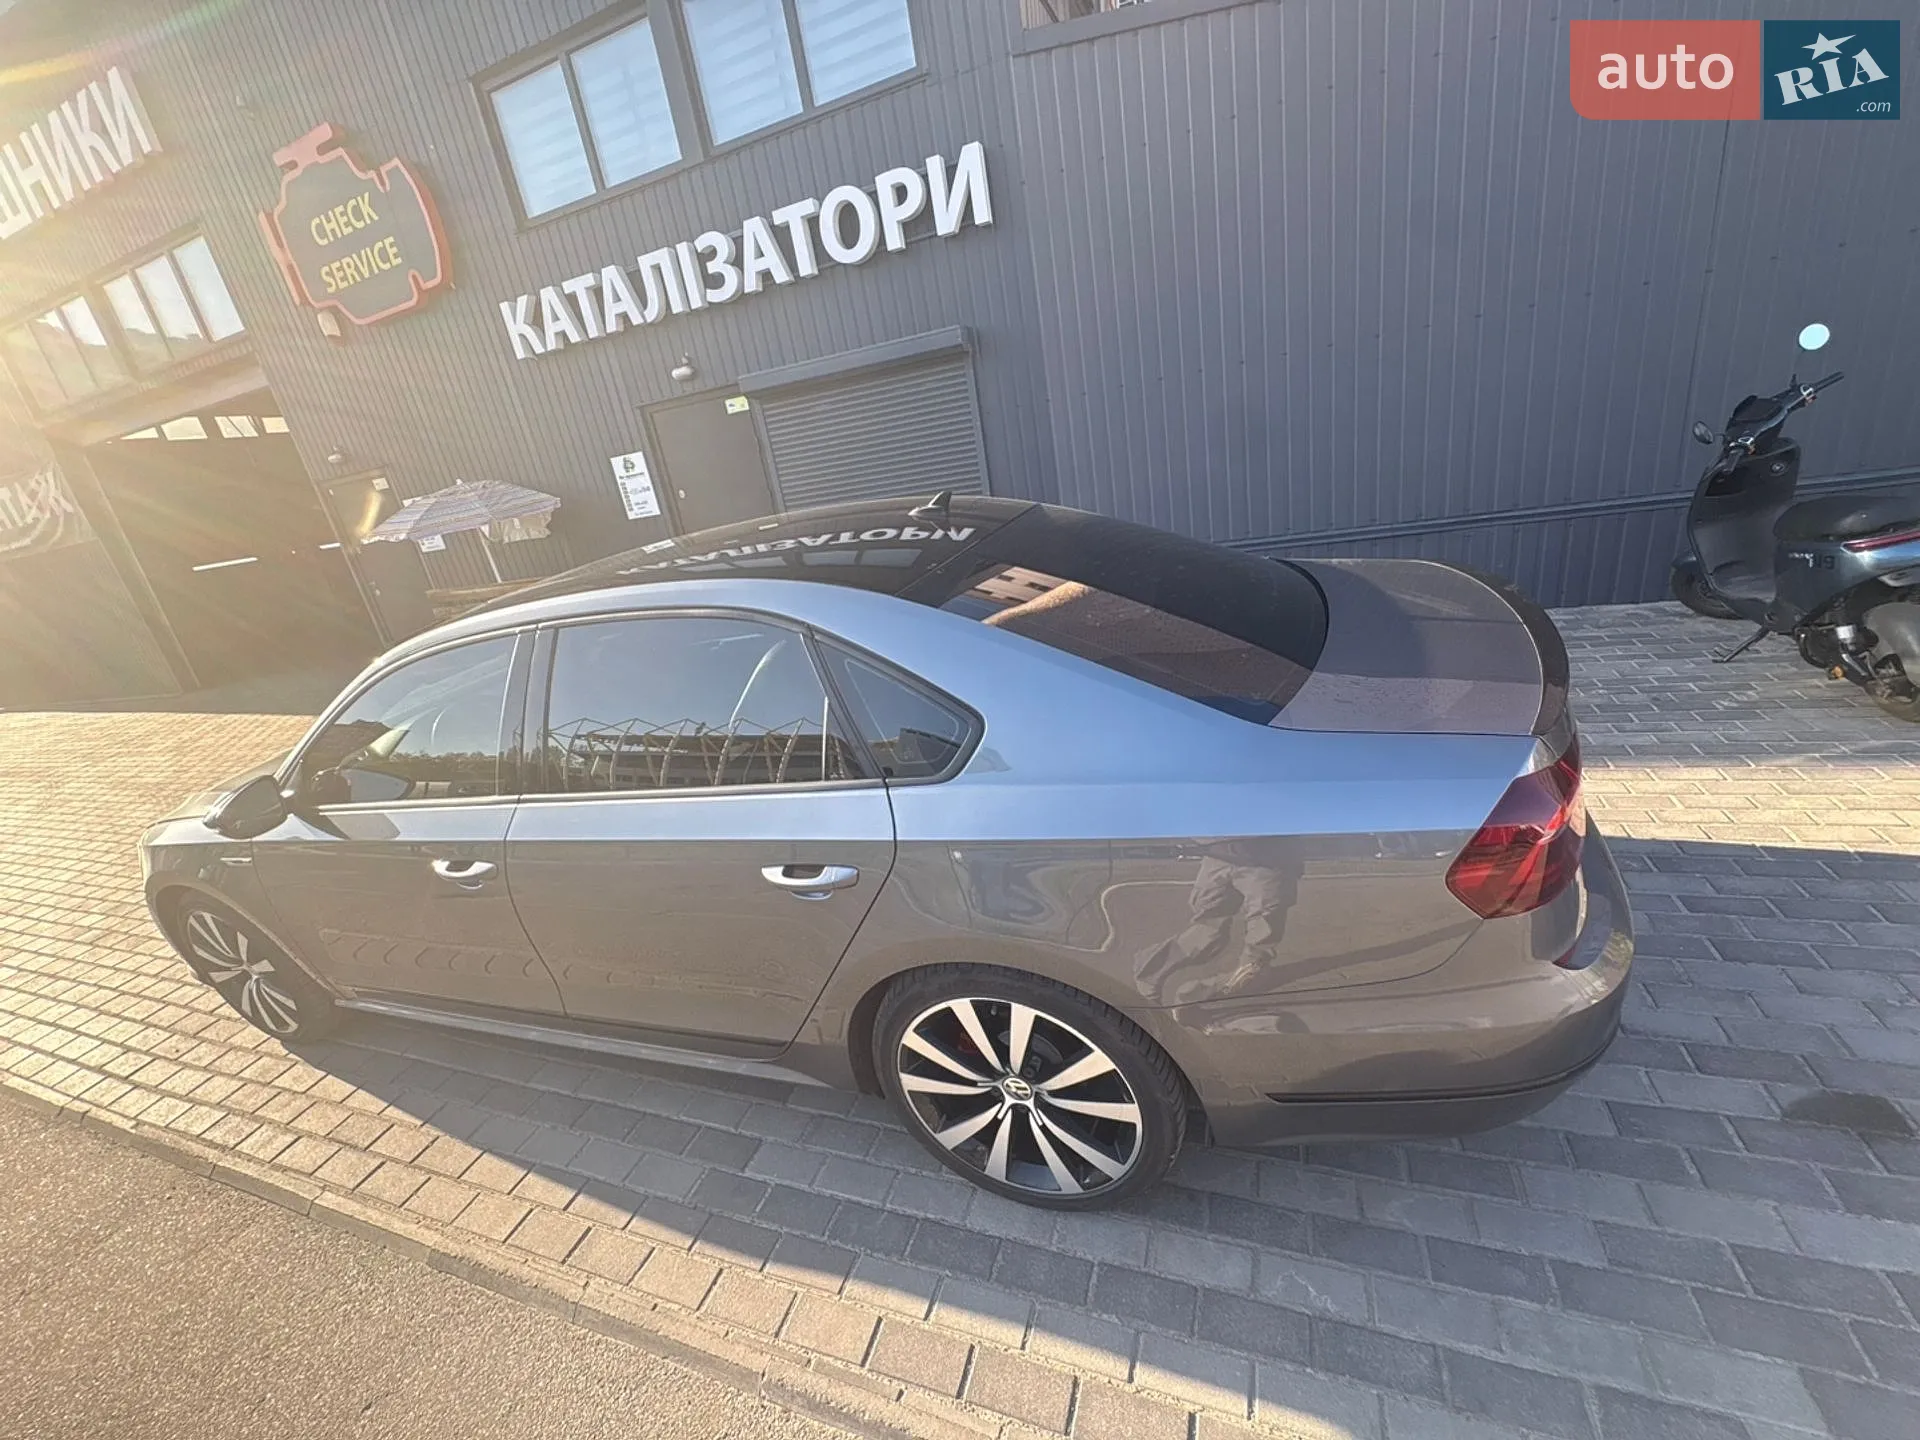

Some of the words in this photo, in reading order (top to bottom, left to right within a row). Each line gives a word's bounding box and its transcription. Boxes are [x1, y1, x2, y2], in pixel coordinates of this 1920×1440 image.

[310, 191, 379, 246] CHECK
[320, 236, 403, 294] SERVICE
[499, 141, 993, 360] КАТАЛІЗАТОРИ
